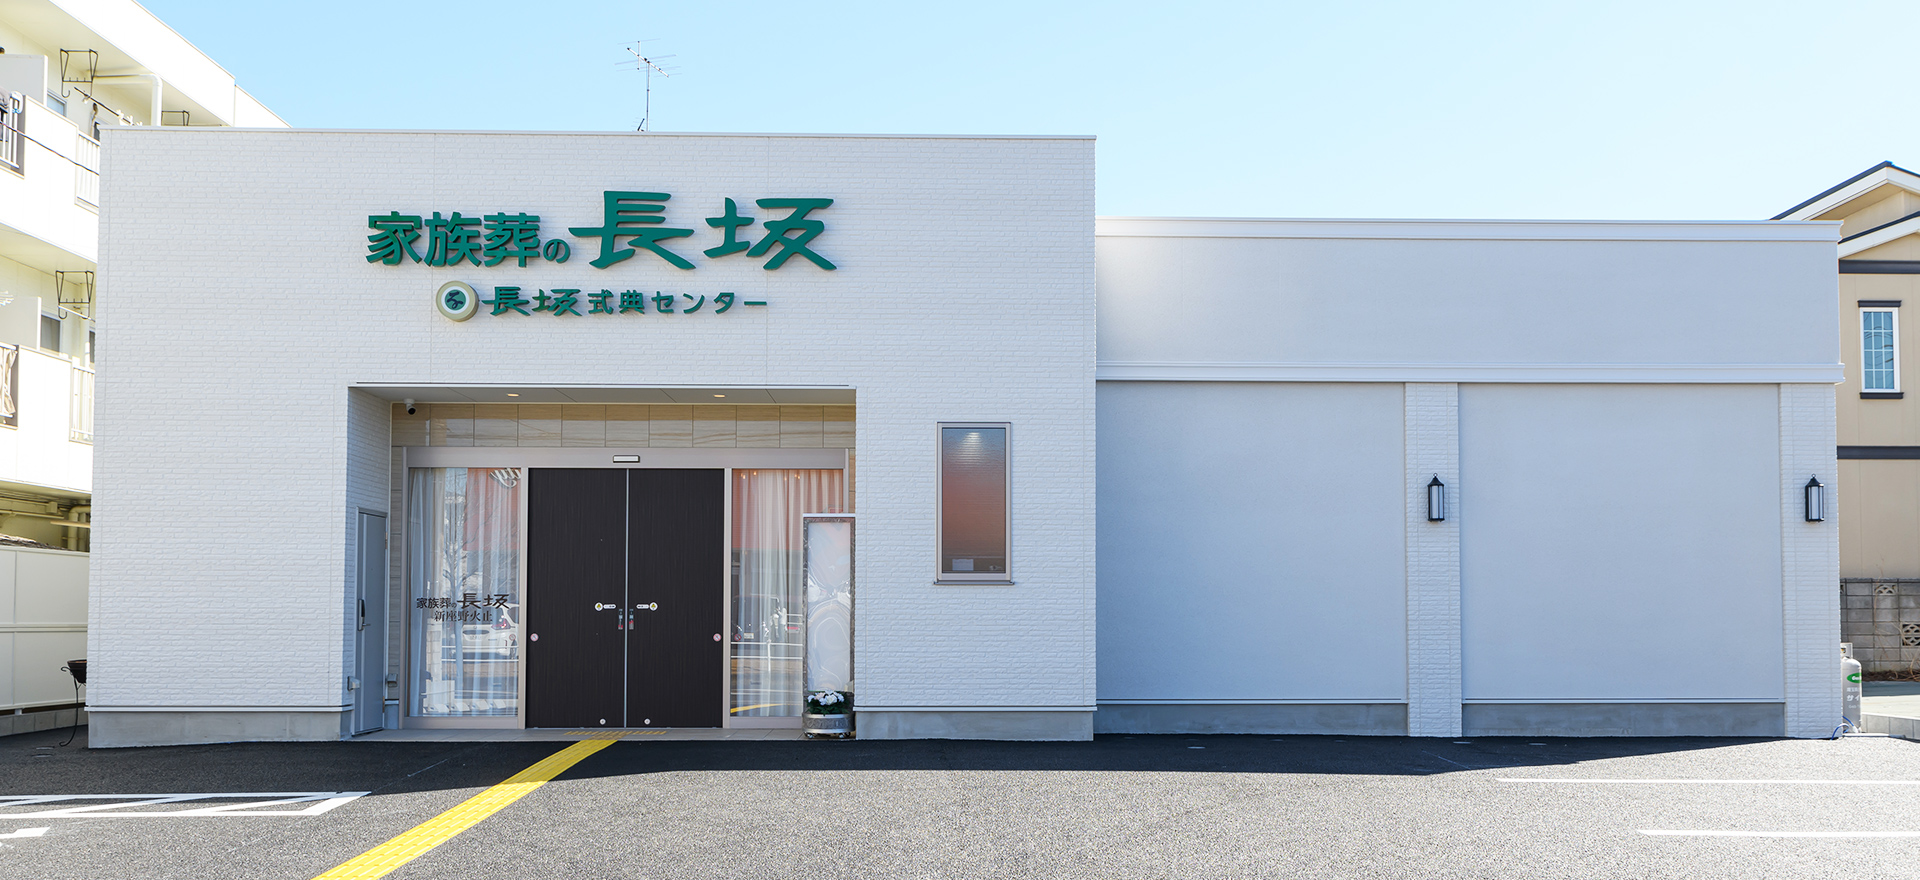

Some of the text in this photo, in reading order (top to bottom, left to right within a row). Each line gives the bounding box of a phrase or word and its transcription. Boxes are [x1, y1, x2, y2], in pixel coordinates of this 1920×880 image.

[366, 190, 837, 271] 家族葬の長坂
[481, 286, 768, 317] 長坂式典センター
[416, 592, 510, 610] 家族葬の長坂
[434, 610, 493, 622] 新座野火止
